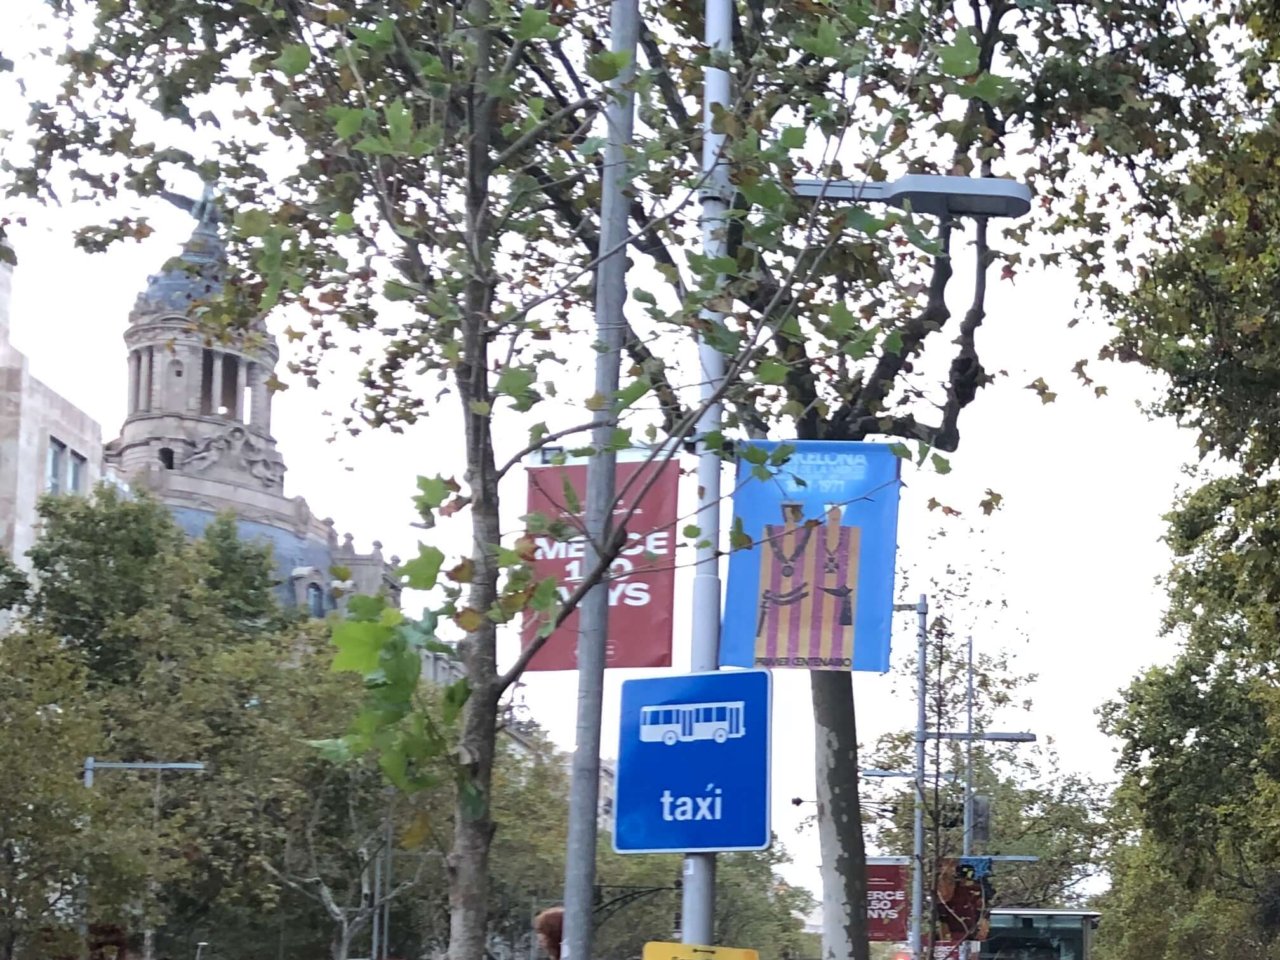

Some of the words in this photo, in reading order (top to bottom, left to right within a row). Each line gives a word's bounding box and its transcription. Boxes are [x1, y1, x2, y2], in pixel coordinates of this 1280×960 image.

[564, 557, 633, 581] 10
[555, 582, 651, 607] YS
[867, 900, 892, 910] 50
[866, 909, 899, 919] NYS
